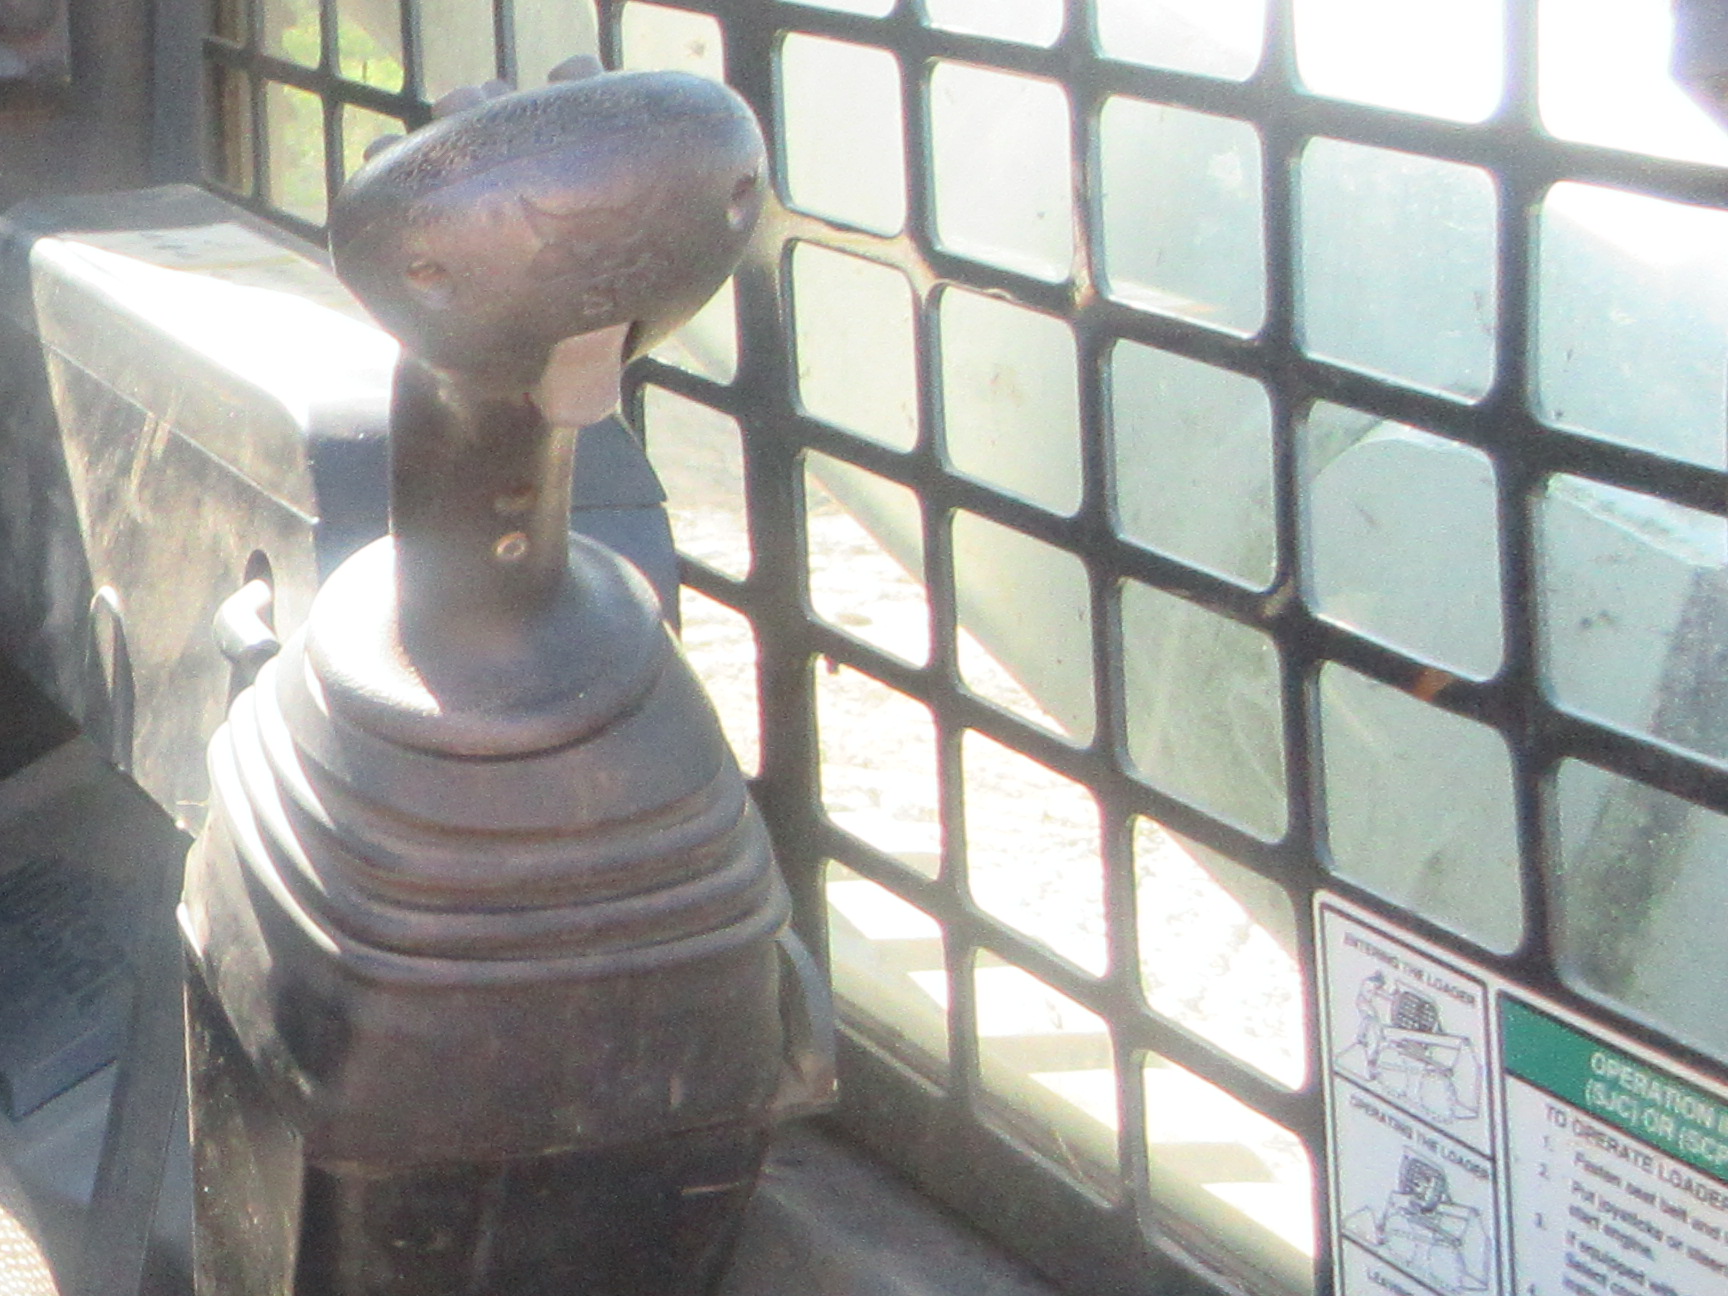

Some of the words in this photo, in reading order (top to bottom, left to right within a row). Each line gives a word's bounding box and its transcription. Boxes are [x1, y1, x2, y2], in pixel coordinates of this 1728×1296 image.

[1426, 971, 1475, 1010] LOADER
[1591, 1052, 1715, 1128] OPERATION
[1545, 1101, 1566, 1130] TO
